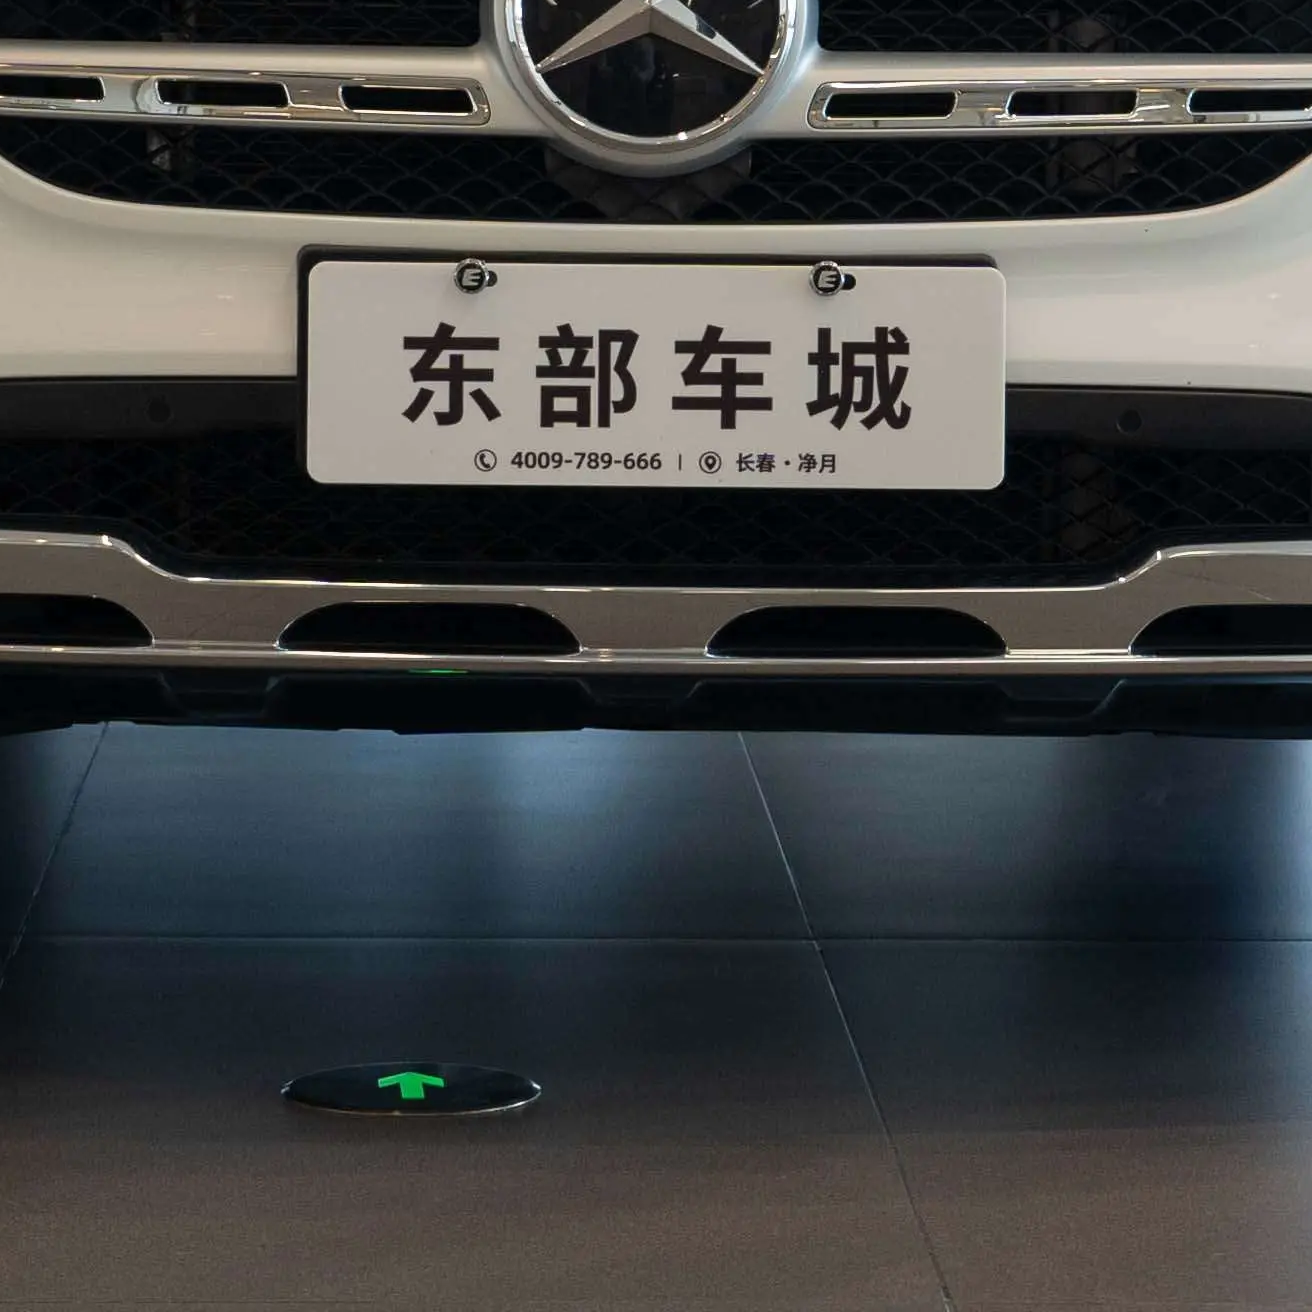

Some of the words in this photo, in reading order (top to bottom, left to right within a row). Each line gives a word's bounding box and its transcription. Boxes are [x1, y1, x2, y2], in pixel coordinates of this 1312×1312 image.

[401, 321, 912, 431] 东部车城
[511, 451, 663, 470] 4009-789-666
